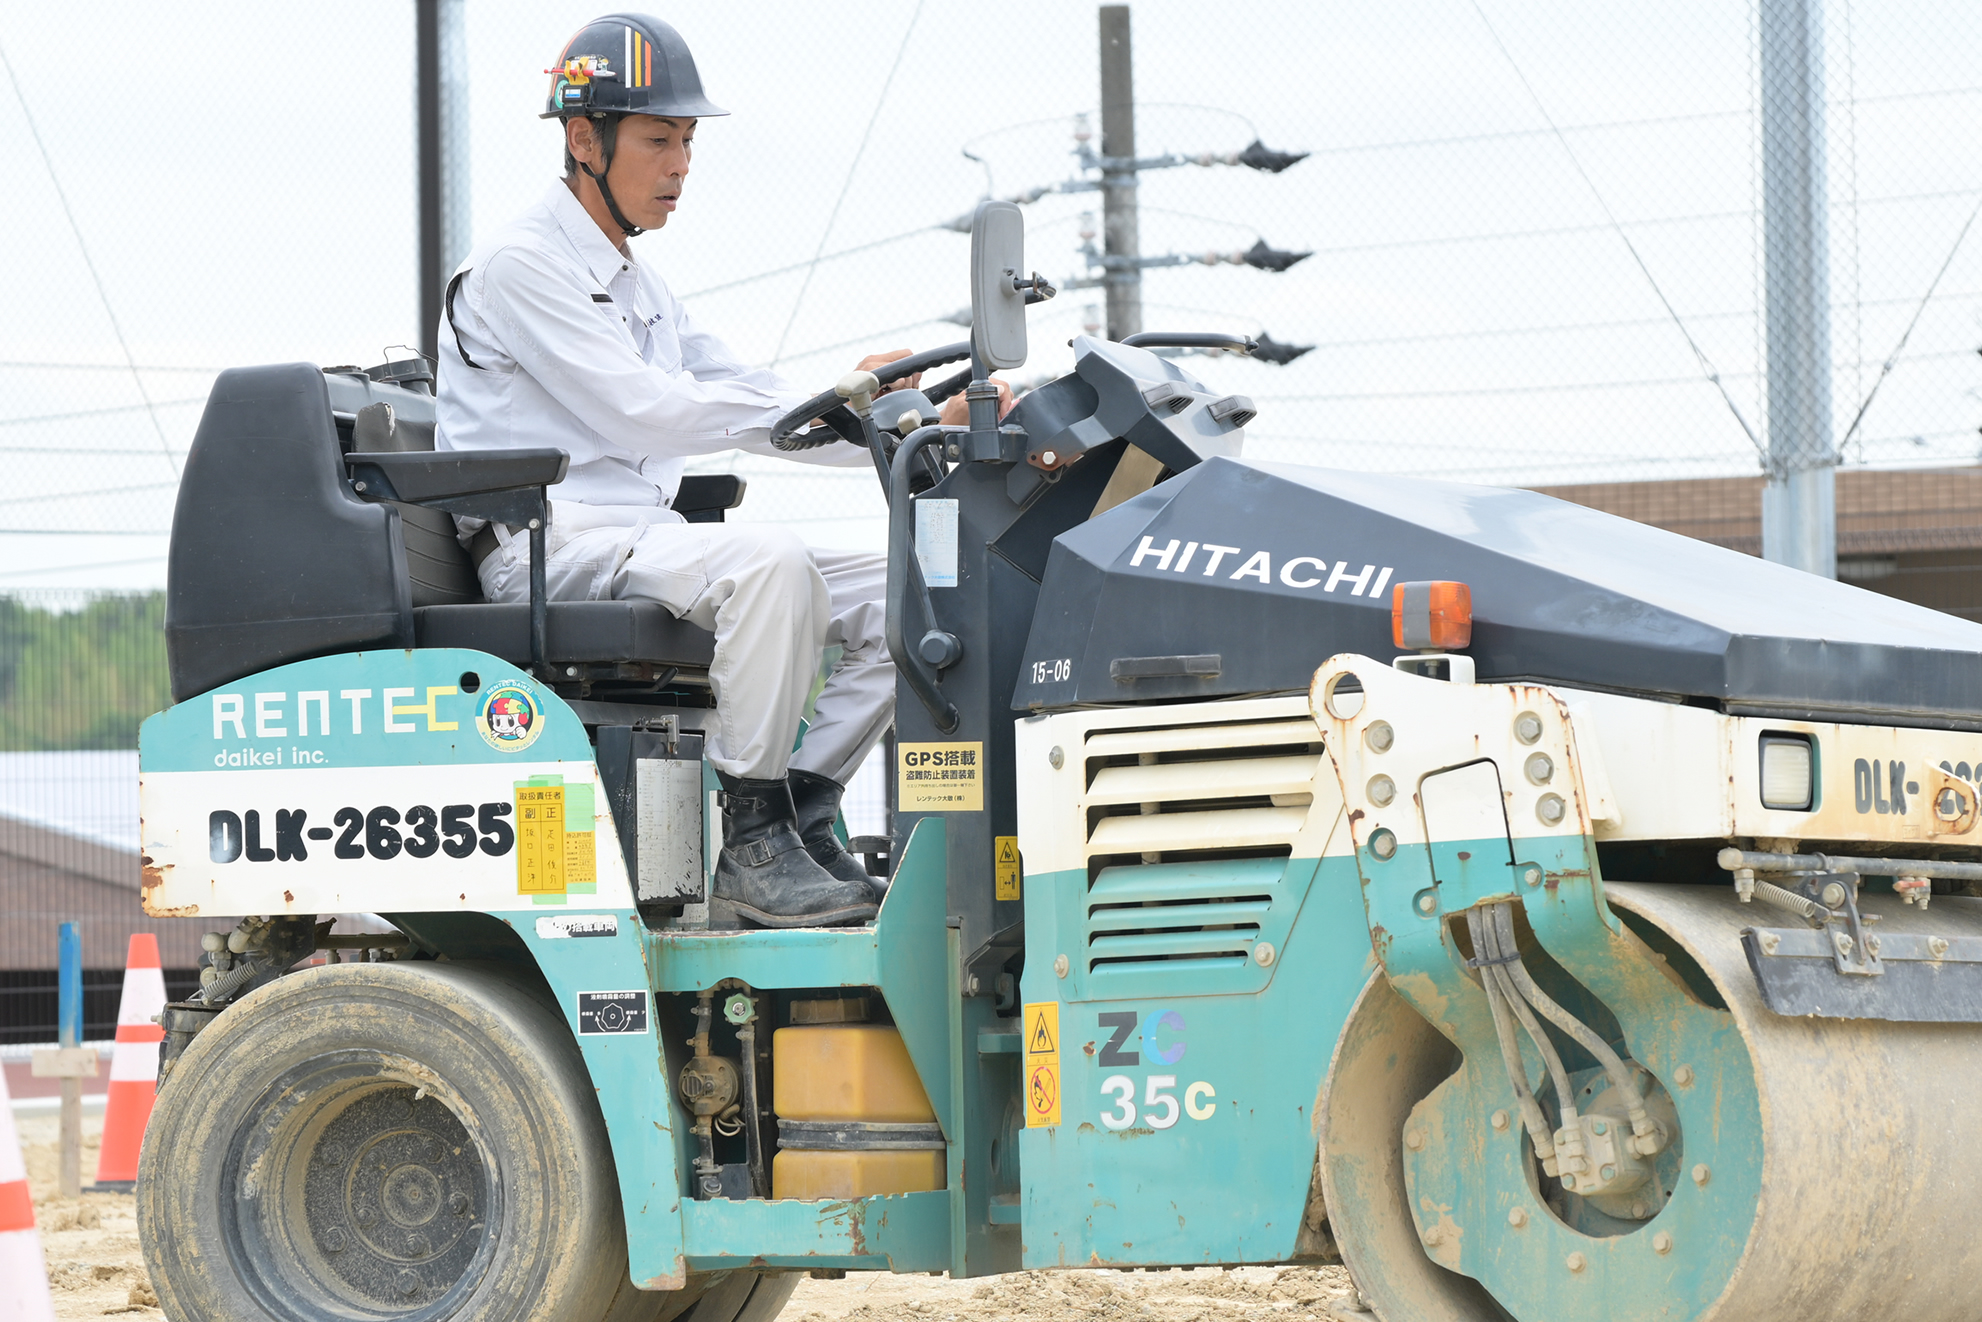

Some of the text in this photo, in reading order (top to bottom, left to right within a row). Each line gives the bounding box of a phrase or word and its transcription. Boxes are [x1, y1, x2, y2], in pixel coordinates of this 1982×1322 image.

[1129, 535, 1394, 600] HITACHI
[1032, 659, 1071, 684] 15-06
[486, 681, 533, 695] RENTEC DAIKEI
[213, 685, 459, 740] RENTEC
[214, 746, 330, 768] daikei inc.
[905, 750, 976, 767] GPS搭載
[905, 769, 976, 781] 盗難防止装置装着
[519, 791, 562, 801] 取扱責任者
[524, 807, 536, 819] 副
[546, 807, 557, 819] 正
[208, 802, 515, 865] DLK-26355
[1098, 1008, 1187, 1068] ZC
